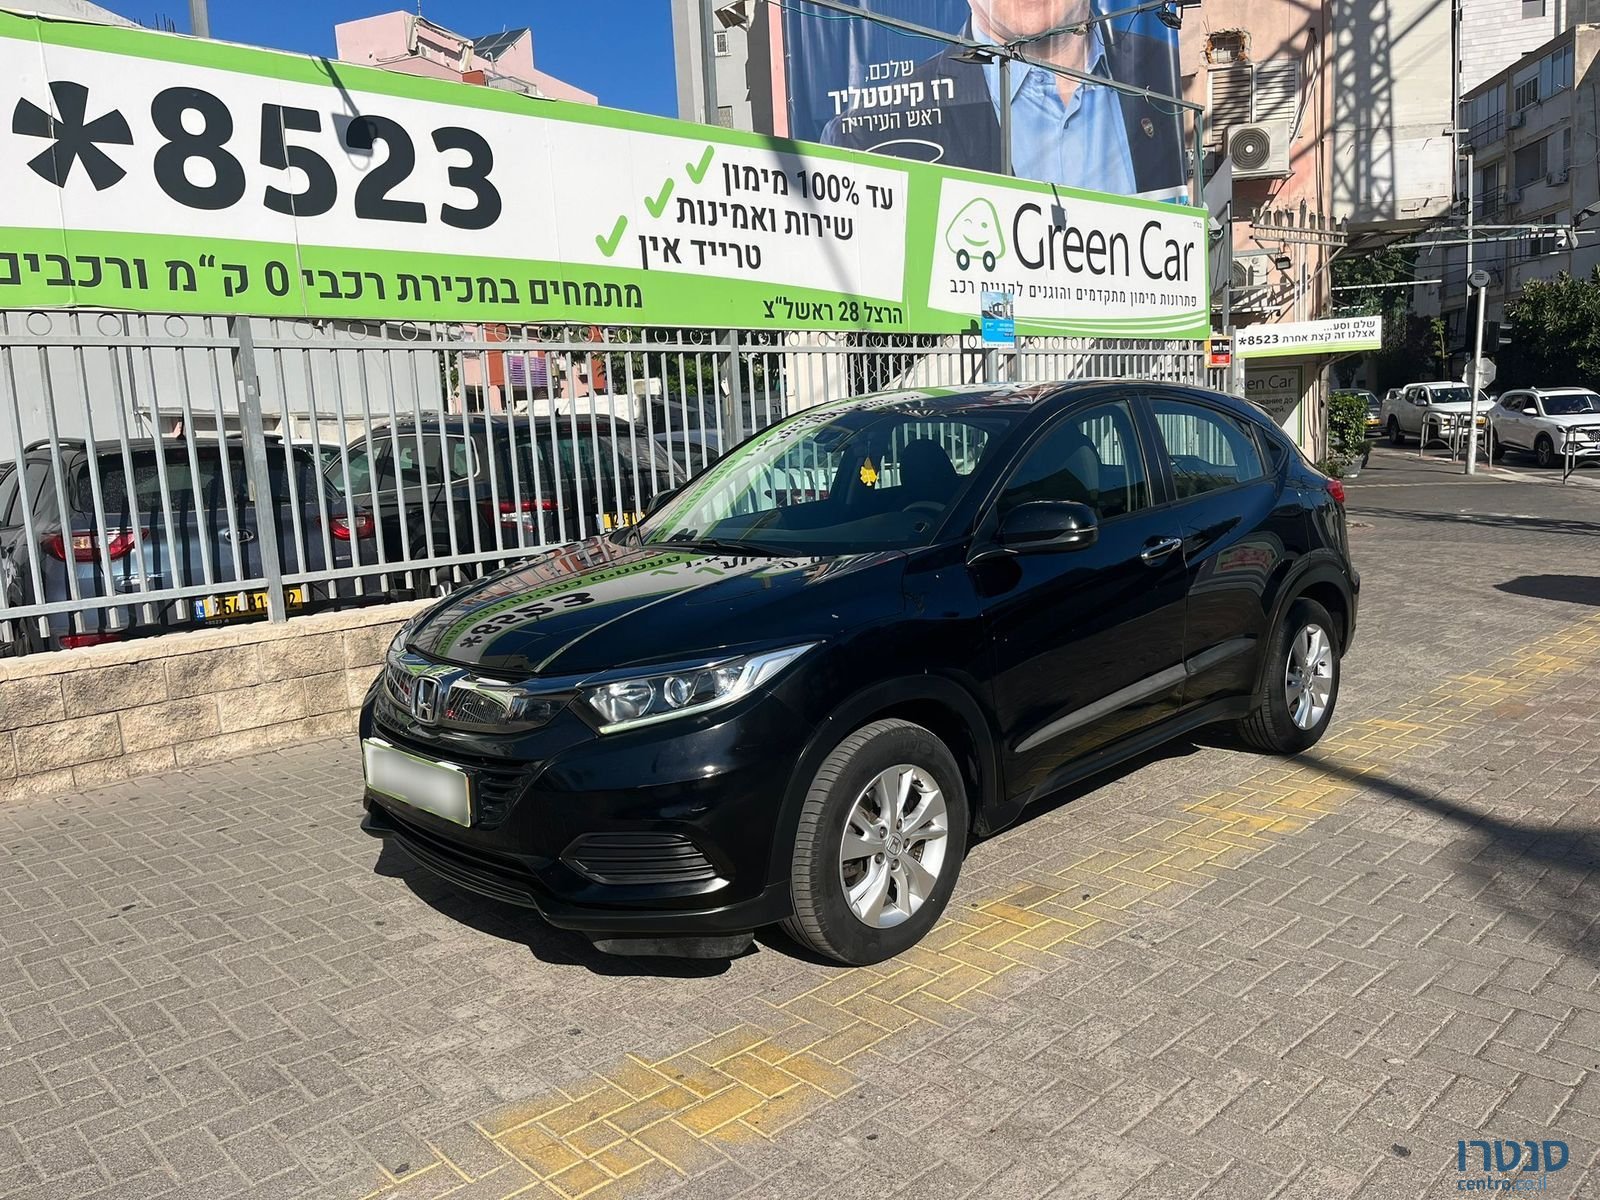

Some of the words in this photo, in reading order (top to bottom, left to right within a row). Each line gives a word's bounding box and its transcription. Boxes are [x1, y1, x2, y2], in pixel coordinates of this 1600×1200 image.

[865, 60, 914, 82] שלכם,
[827, 81, 924, 115] קינסטליך
[930, 78, 954, 100] רז
[842, 112, 900, 134] העירייה
[906, 108, 941, 128] ראש
[722, 162, 787, 196] מימון
[797, 170, 859, 206] 100%
[866, 185, 893, 210] עד
[676, 197, 776, 232] ואמינות
[785, 210, 853, 241] שירות
[638, 233, 680, 270] אין
[1013, 202, 1129, 277] Green
[1140, 220, 1194, 282] Car
[690, 239, 761, 270] טרייד
[264, 260, 290, 297] 0
[301, 269, 386, 300] רכבי
[397, 273, 520, 303] במכירת
[950, 279, 975, 295] רכב
[528, 279, 643, 308] מתמחים
[1029, 285, 1071, 301] והוגנים
[1076, 288, 1126, 306] מתקדמים
[1131, 292, 1156, 306] מימון
[1160, 295, 1197, 308] פתרונות
[838, 301, 860, 322] 28
[864, 301, 903, 324] הרצל
[1334, 331, 1345, 339] זה
[1348, 330, 1376, 339] אצלנו
[1353, 320, 1376, 329] שלם
[1269, 374, 1294, 389] Car
